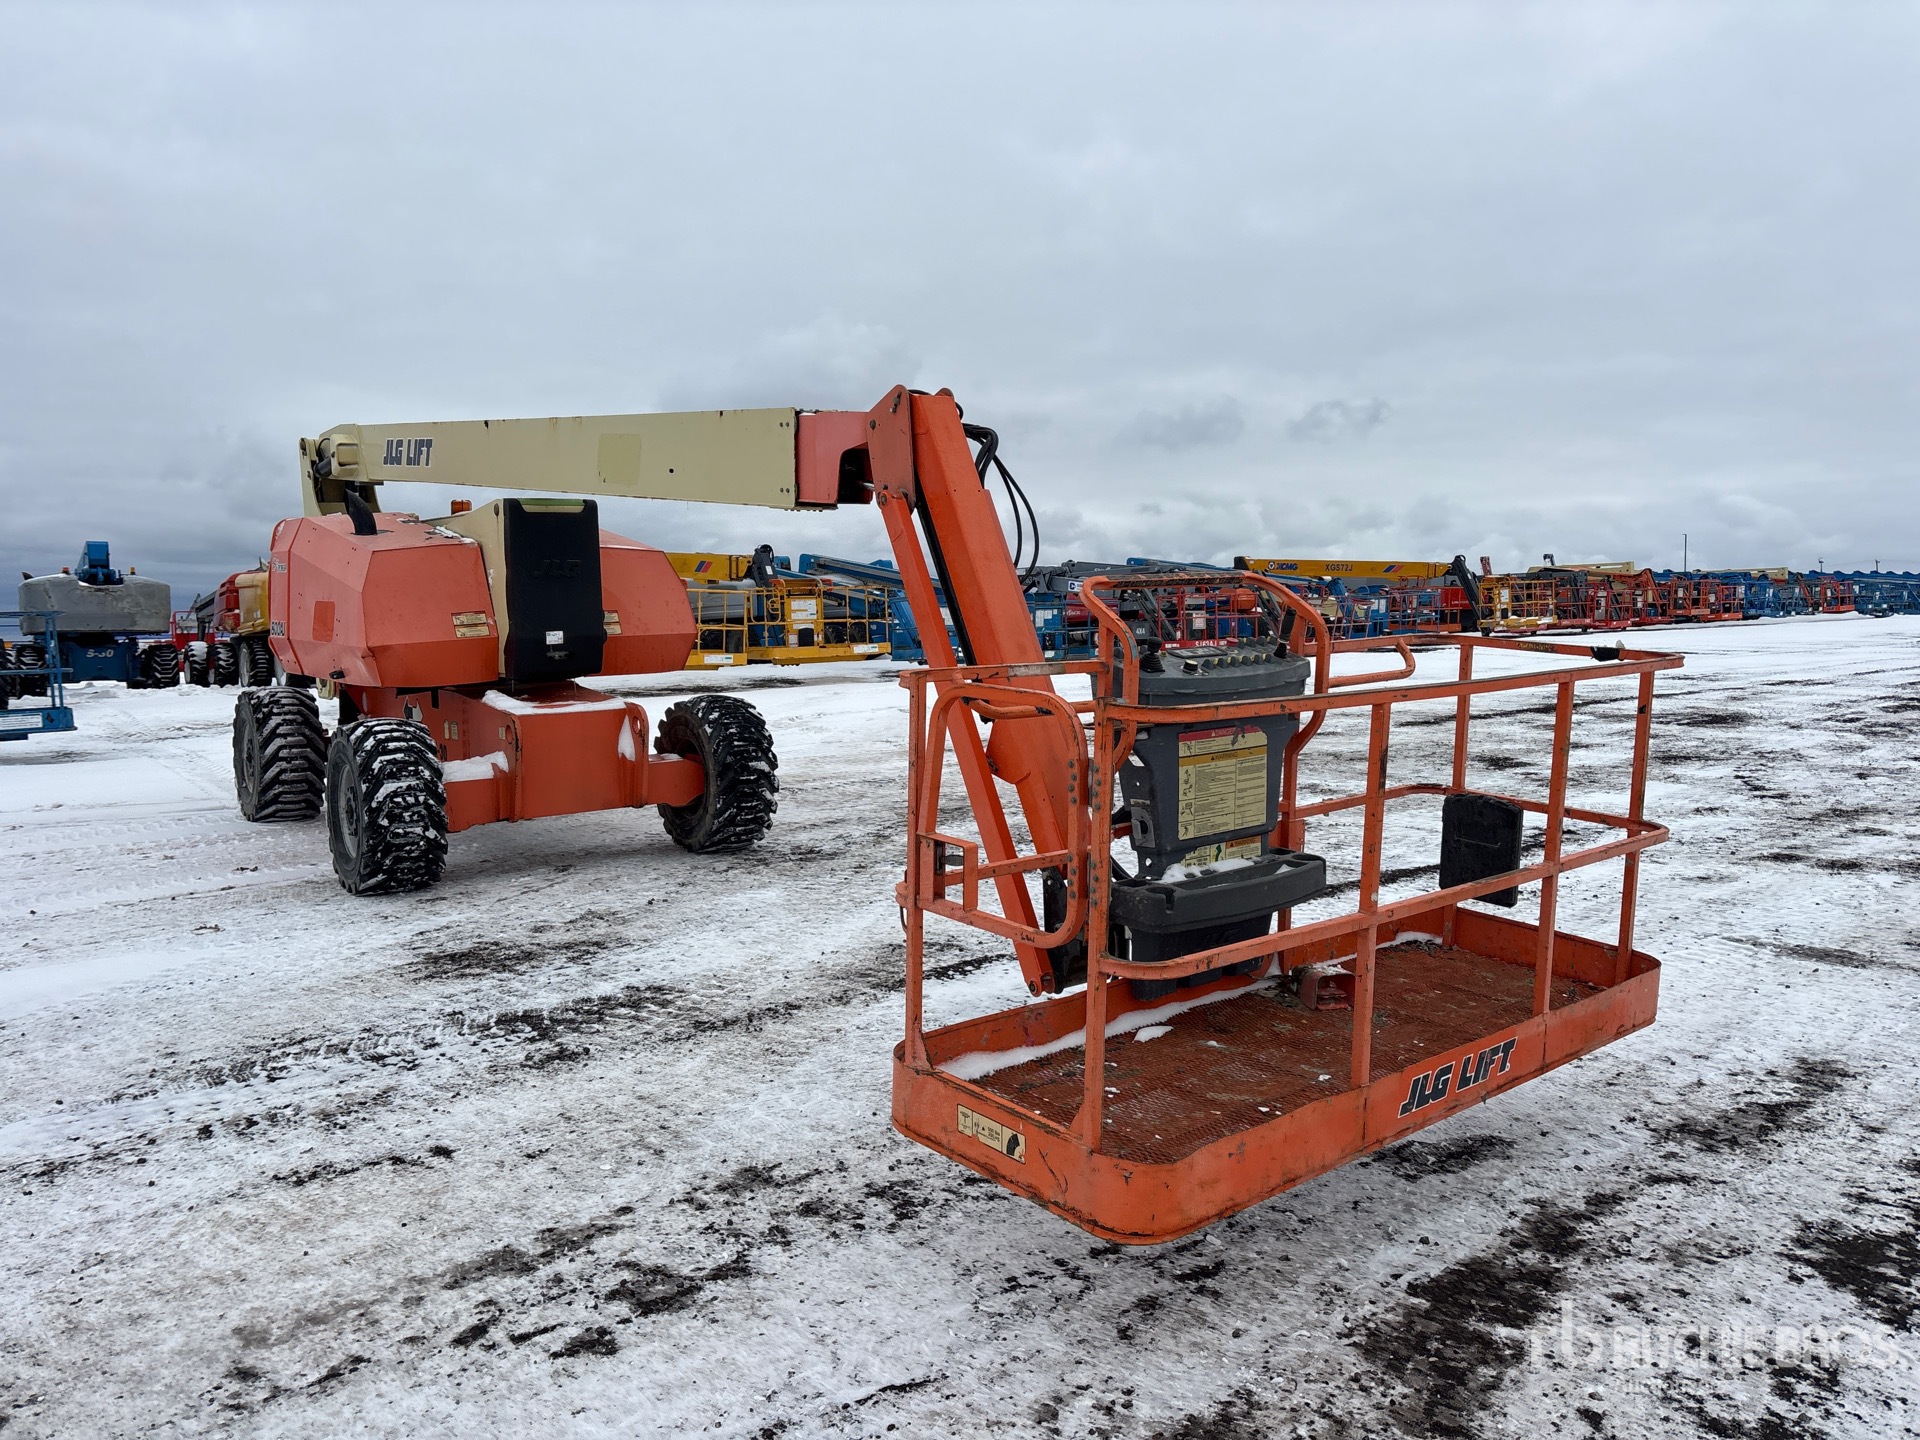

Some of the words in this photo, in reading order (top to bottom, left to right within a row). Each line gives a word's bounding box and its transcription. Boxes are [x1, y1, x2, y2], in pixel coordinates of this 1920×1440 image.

[382, 438, 404, 467] JLG
[406, 438, 433, 467] LIFT
[1276, 562, 1298, 571] XCMG
[1325, 563, 1354, 572] XGS72J
[1215, 727, 1238, 737] DANGE
[1398, 1061, 1456, 1118] JLG
[1456, 1036, 1518, 1093] LIFT
